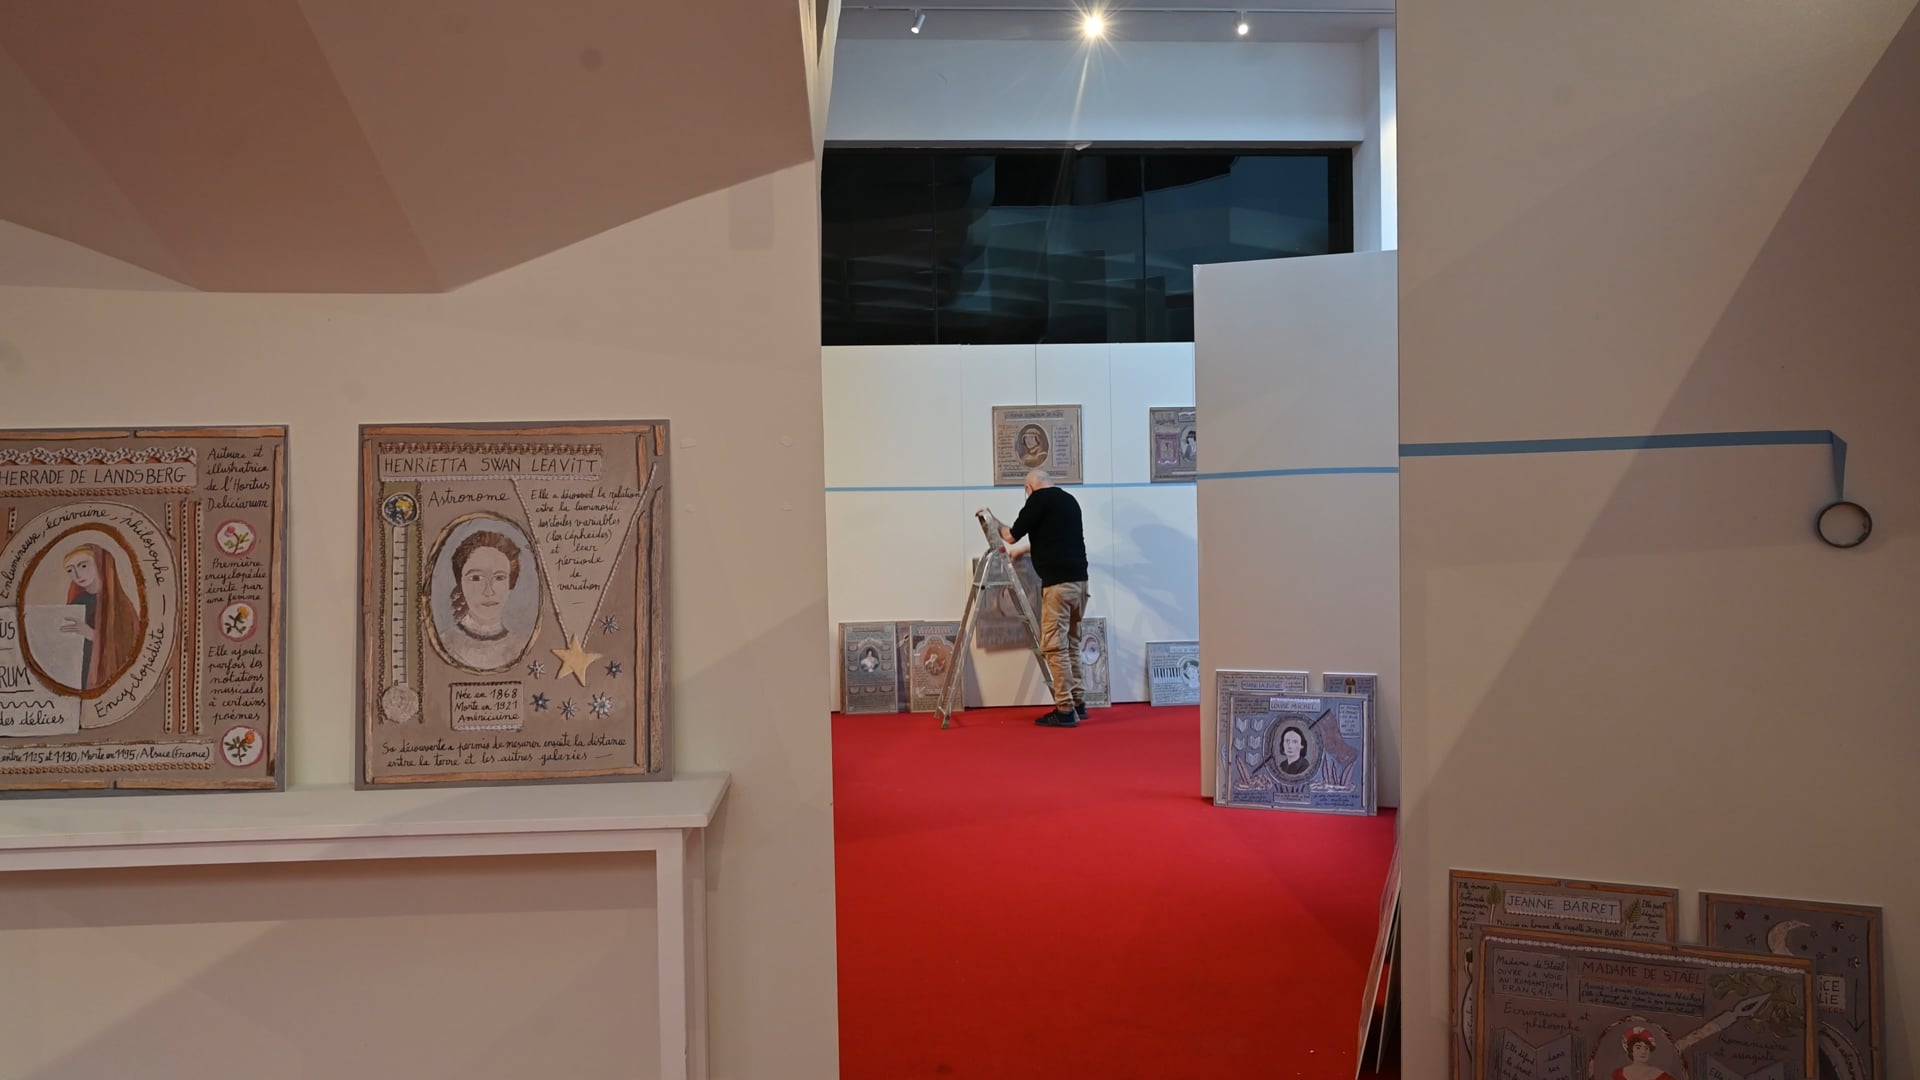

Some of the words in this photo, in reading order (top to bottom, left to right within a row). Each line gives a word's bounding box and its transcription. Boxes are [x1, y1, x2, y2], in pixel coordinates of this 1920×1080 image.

[252, 444, 263, 457] et
[206, 461, 269, 475] illustratrice
[481, 458, 521, 472] SWAN
[0, 469, 65, 486] HERRADE
[71, 469, 88, 484] DE
[94, 467, 187, 484] LANDSBERG
[204, 478, 218, 491] de
[428, 488, 511, 507] Astronome
[531, 489, 549, 500] Elle
[575, 513, 621, 527] variables
[119, 513, 169, 587] philosophe
[550, 544, 560, 554] et
[205, 568, 267, 585] encyclopédie
[570, 568, 582, 578] de
[206, 581, 238, 594] écrite
[241, 582, 263, 594] par
[557, 579, 601, 591] variation
[206, 596, 225, 604] une
[226, 592, 261, 606] femme
[0, 619, 16, 640] US
[208, 644, 228, 657] Elle
[231, 643, 264, 660] ajoute
[94, 622, 164, 718] Encyclopédiste
[208, 658, 245, 675] parfois
[249, 657, 263, 669] les
[210, 670, 264, 684] notations
[210, 681, 264, 695] musicales
[456, 688, 472, 700] Née
[489, 688, 518, 700] 1868
[208, 696, 217, 707] à
[222, 695, 266, 707] certains
[454, 701, 480, 712] Morte
[493, 700, 518, 711] 1921
[18, 710, 65, 726] délices
[399, 737, 446, 753] découverte
[457, 737, 490, 758] permis
[506, 740, 541, 750] mesurer
[575, 733, 585, 747] la
[587, 732, 627, 747] distance
[81, 748, 105, 761] Morte
[386, 755, 416, 768] entre
[433, 753, 461, 767] terre
[464, 753, 478, 765] et
[481, 752, 495, 764] les
[498, 750, 533, 762] autres
[538, 749, 588, 766] galaxies
[1507, 895, 1553, 910] JEANNE
[1563, 899, 1618, 916] BARRET
[1496, 955, 1529, 968] Madame
[1527, 971, 1537, 979] LA
[1582, 961, 1637, 977] MADAME
[1644, 967, 1656, 980] DE
